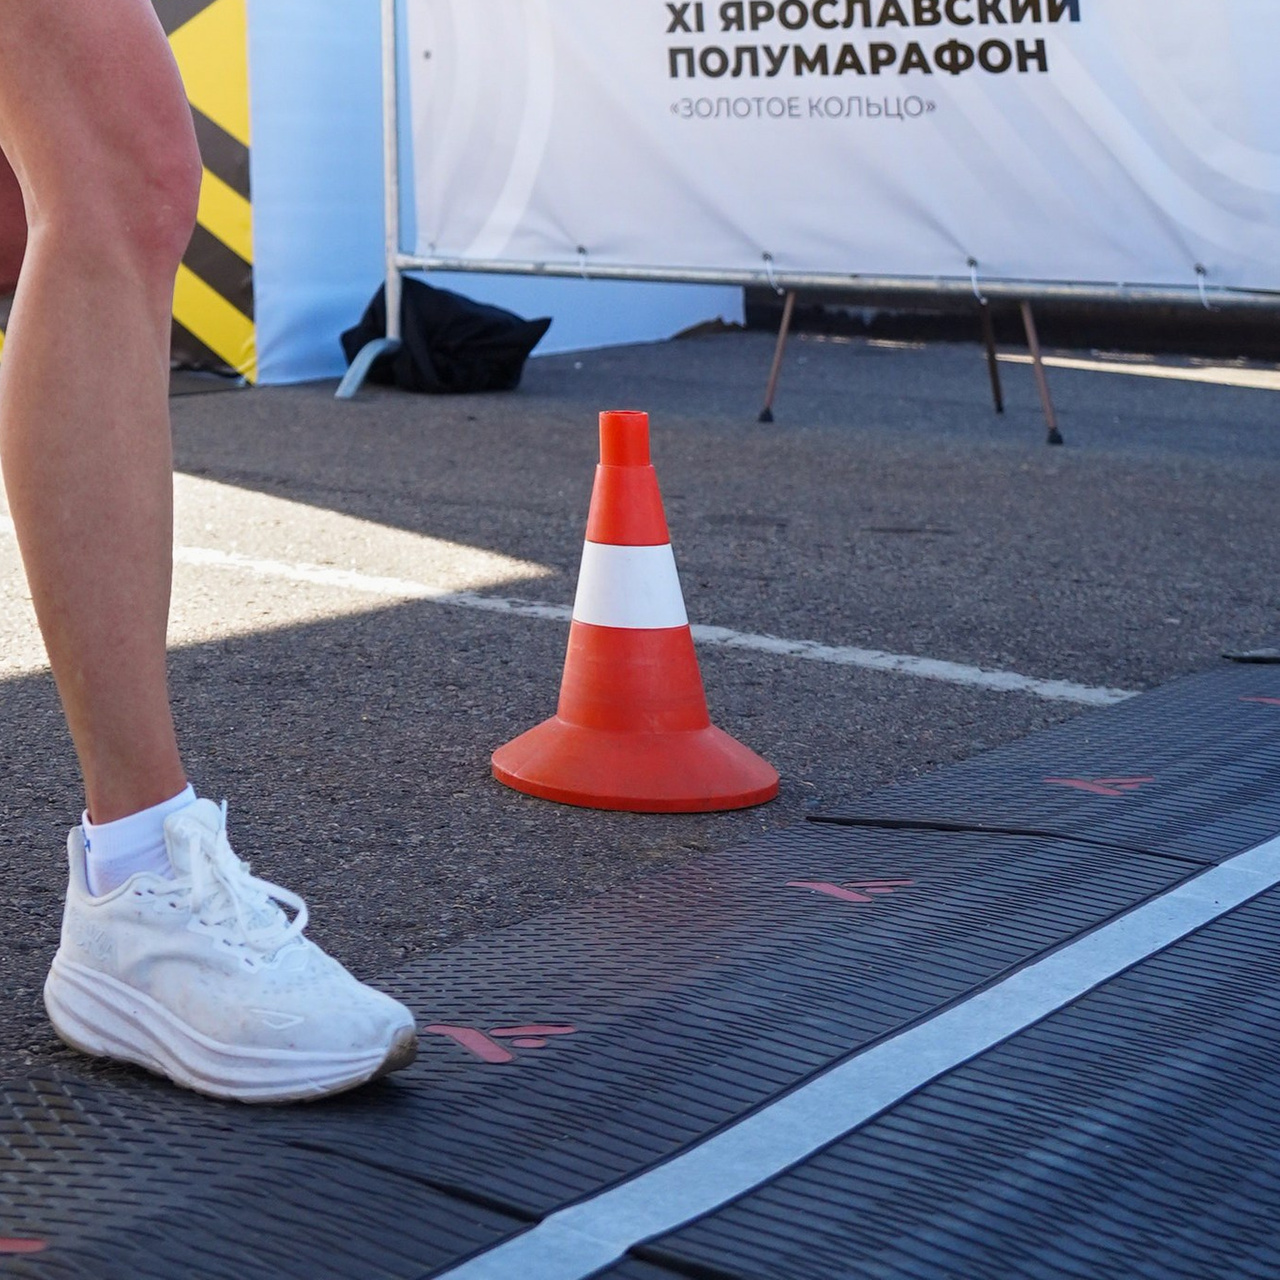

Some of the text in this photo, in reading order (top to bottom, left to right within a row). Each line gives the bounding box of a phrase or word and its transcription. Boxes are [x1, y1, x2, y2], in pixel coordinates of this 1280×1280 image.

[665, 1, 705, 33] XI
[667, 38, 1049, 79] ПОЛУМАРАФОН
[669, 95, 937, 121] «ЗОЛОТОЕ КОЛЬЦО»
